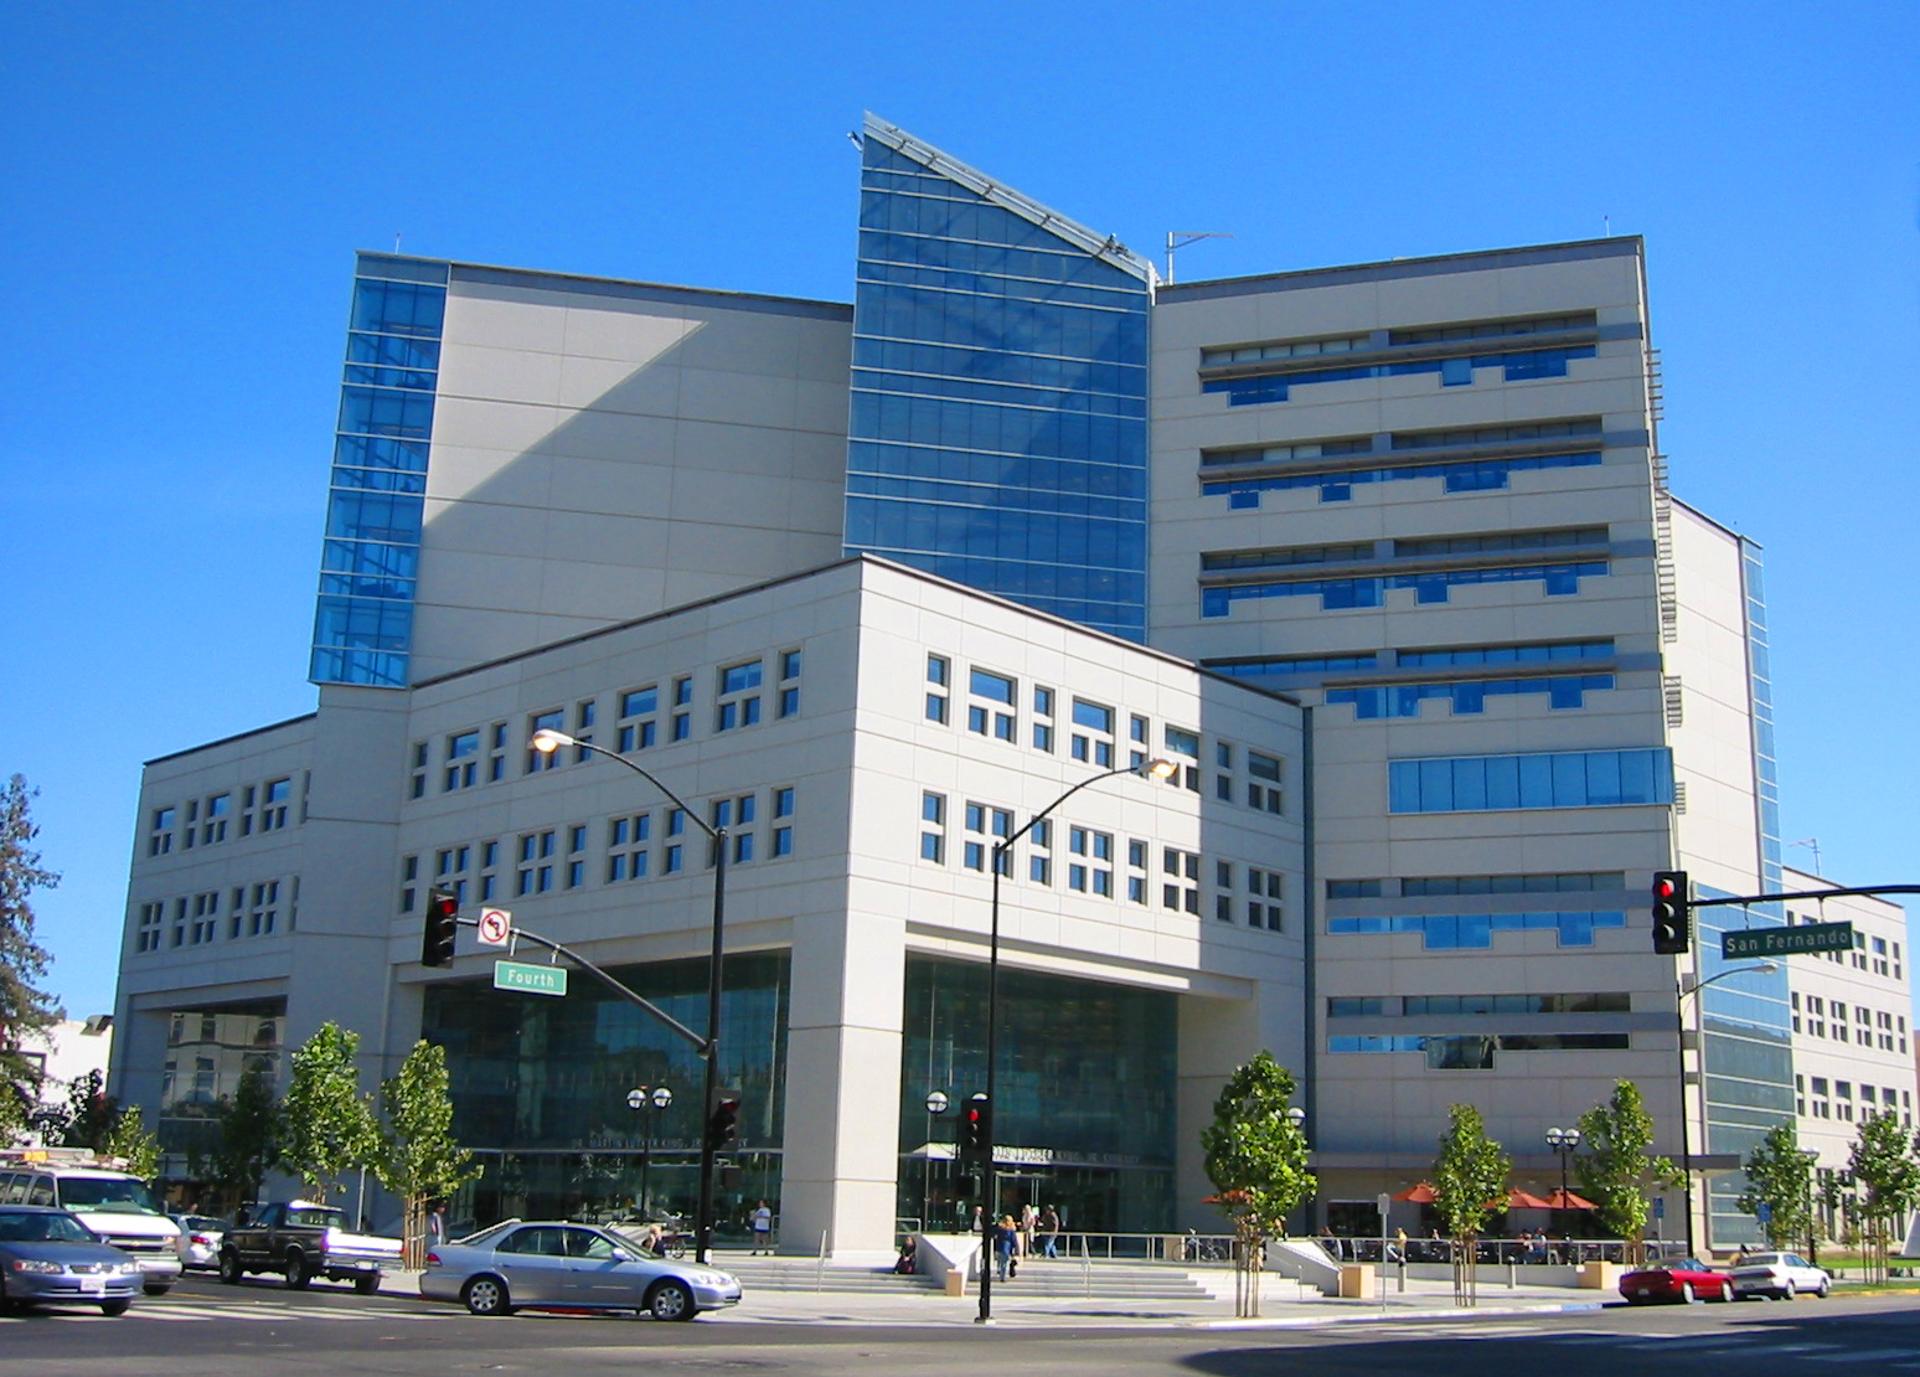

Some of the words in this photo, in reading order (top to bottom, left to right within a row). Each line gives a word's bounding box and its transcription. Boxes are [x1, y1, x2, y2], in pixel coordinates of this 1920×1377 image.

[1726, 937, 1758, 952] San
[1766, 930, 1848, 949] Fernando
[508, 969, 555, 987] Fourth
